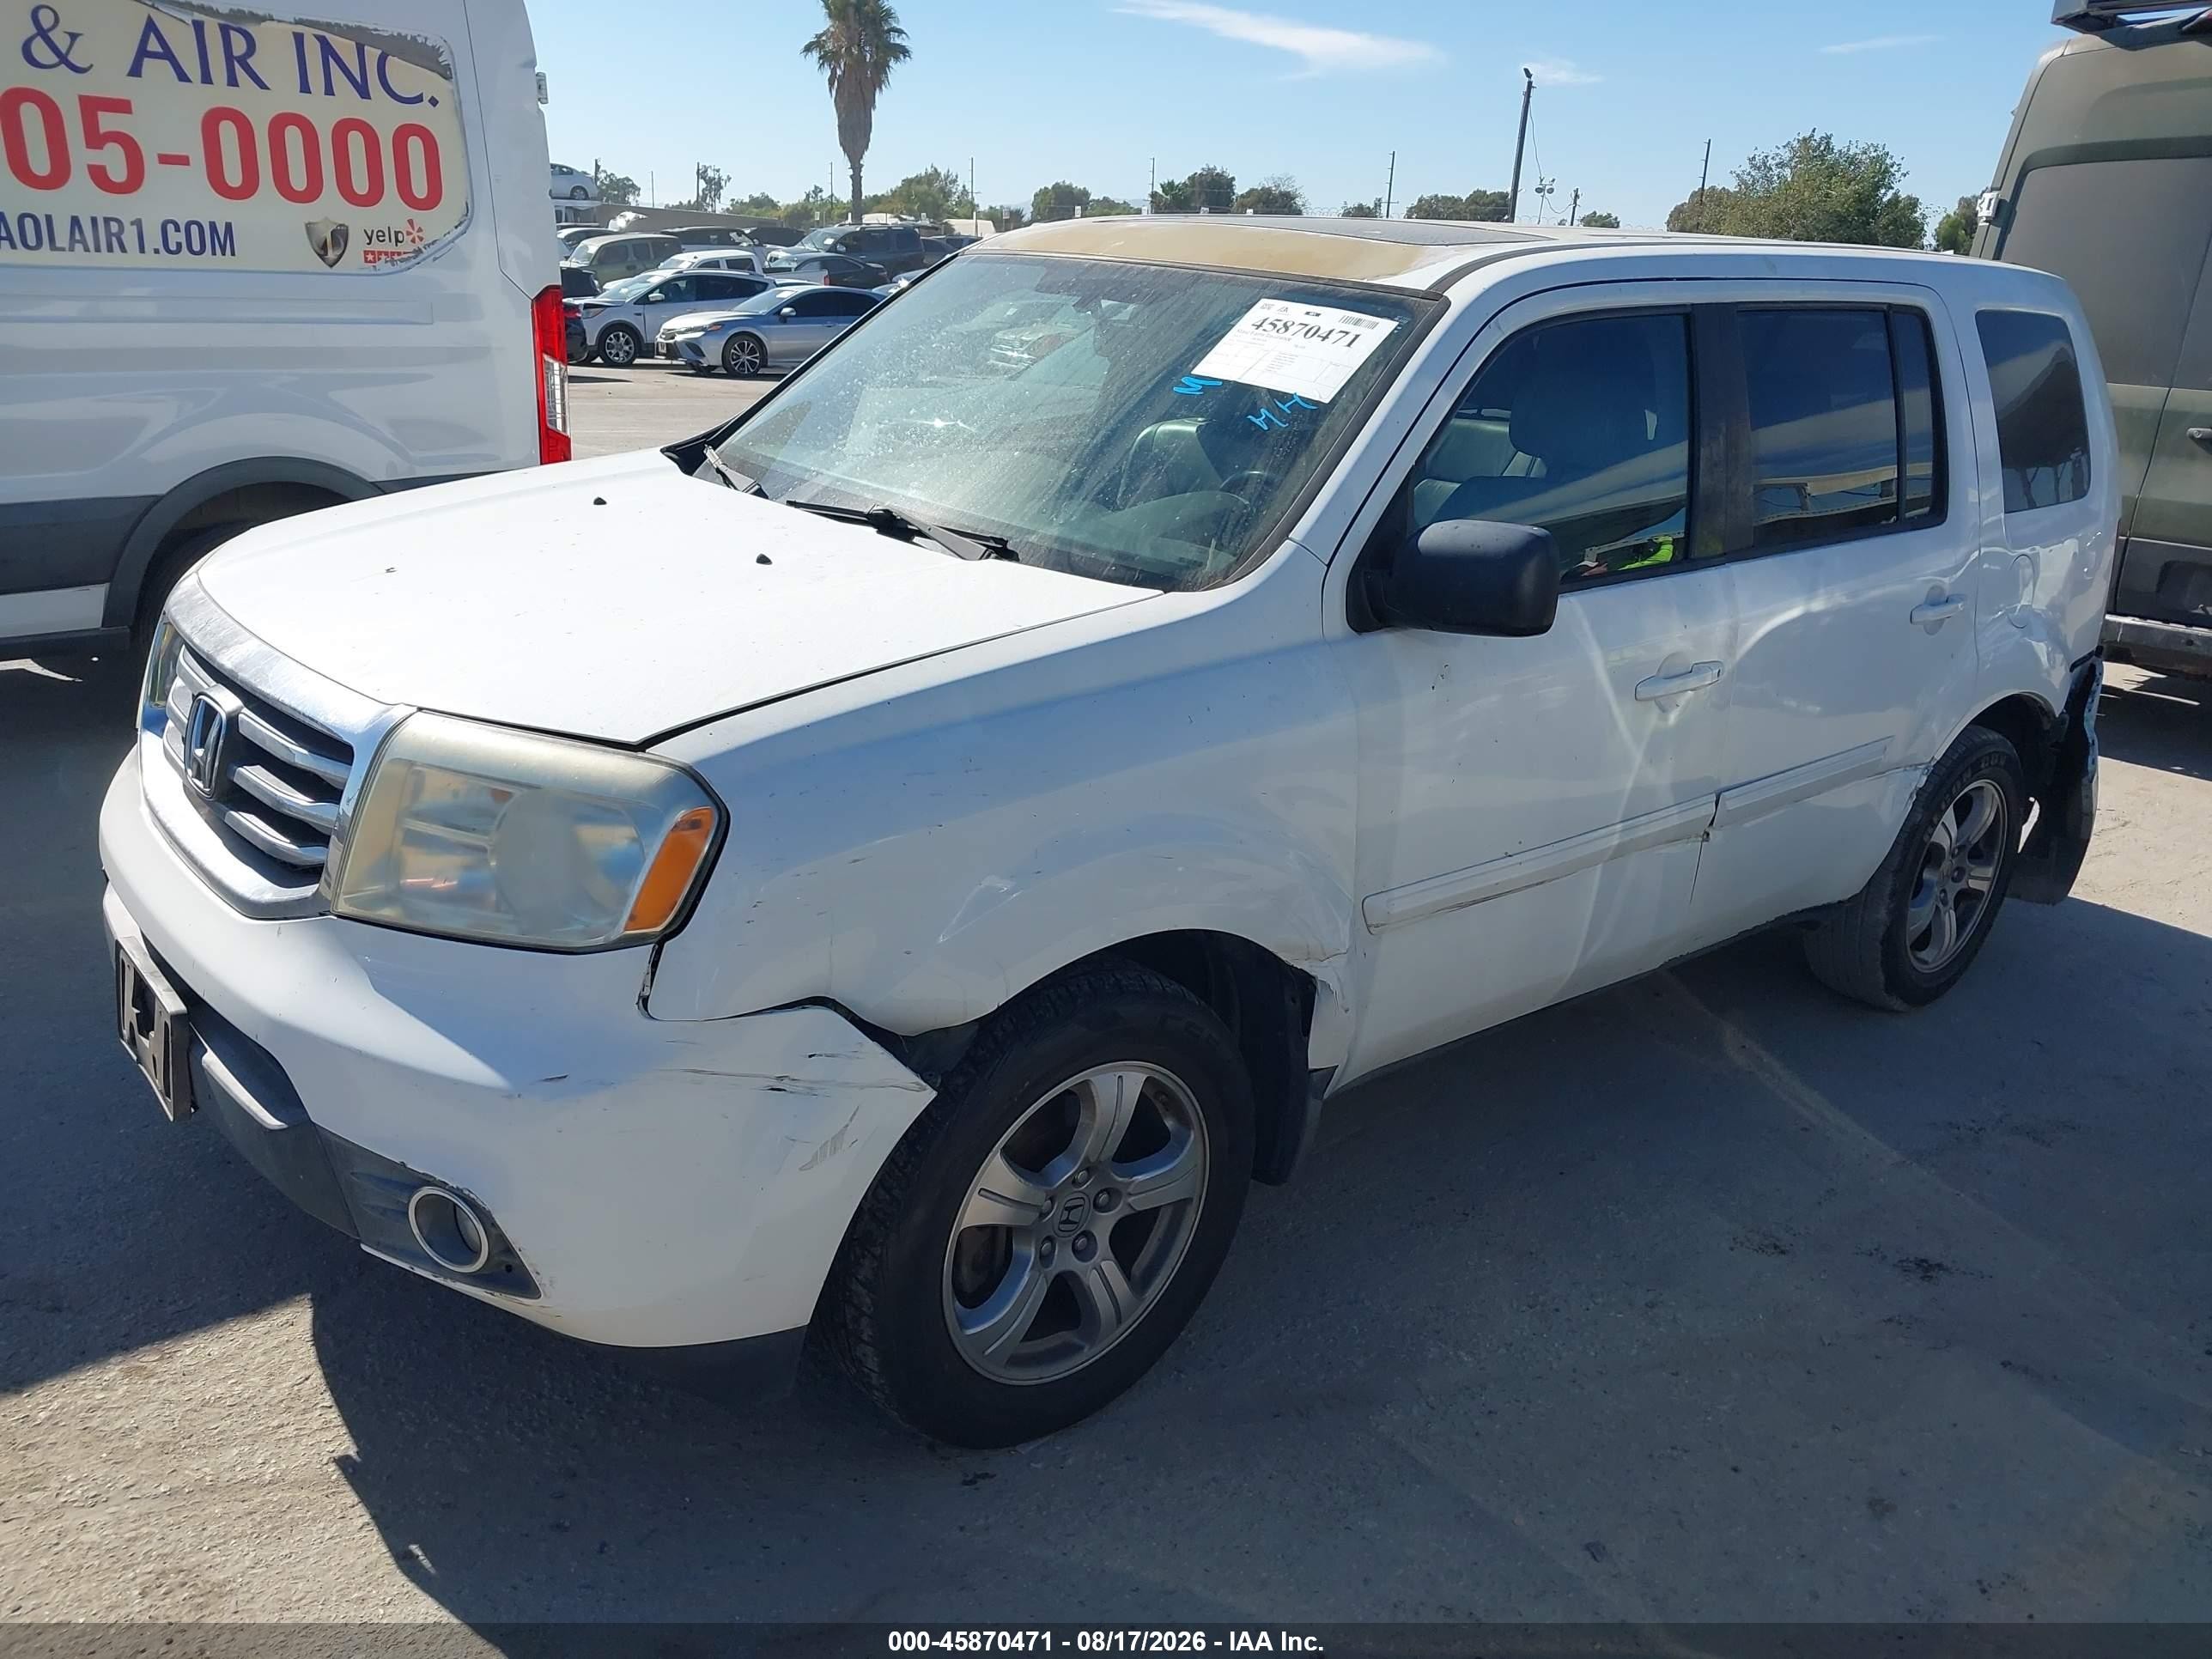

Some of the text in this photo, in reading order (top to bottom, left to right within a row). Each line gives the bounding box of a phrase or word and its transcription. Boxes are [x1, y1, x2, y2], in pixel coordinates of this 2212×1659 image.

[21, 4, 440, 108] & AIR INC.
[0, 87, 444, 211] 05-0000
[0, 210, 236, 257] AOLAIR1.COM
[363, 226, 405, 246] yelp
[1251, 316, 1360, 349] 45870471
